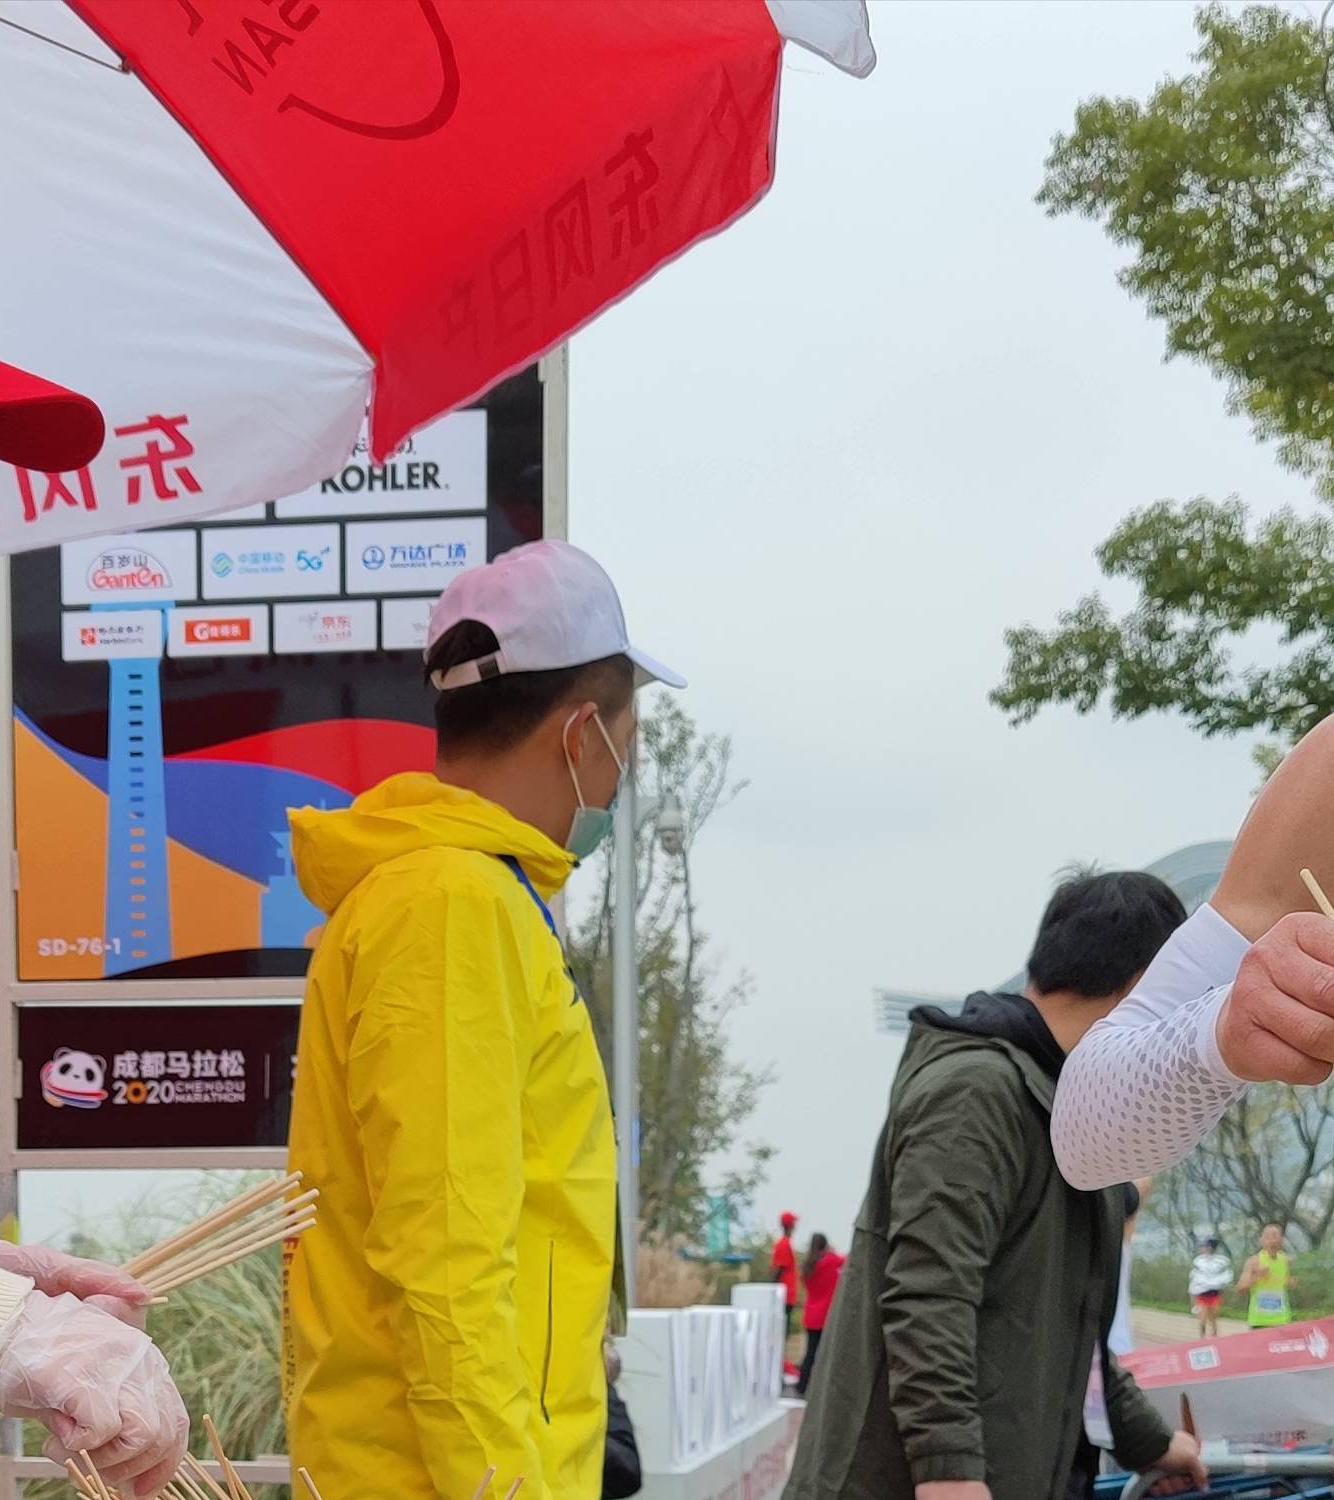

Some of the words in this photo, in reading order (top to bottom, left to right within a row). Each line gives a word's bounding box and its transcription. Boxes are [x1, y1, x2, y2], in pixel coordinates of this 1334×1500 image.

[38, 937, 121, 957] SD-76-1
[112, 1050, 246, 1078] 成都马拉松
[112, 1080, 175, 1104] 2020
